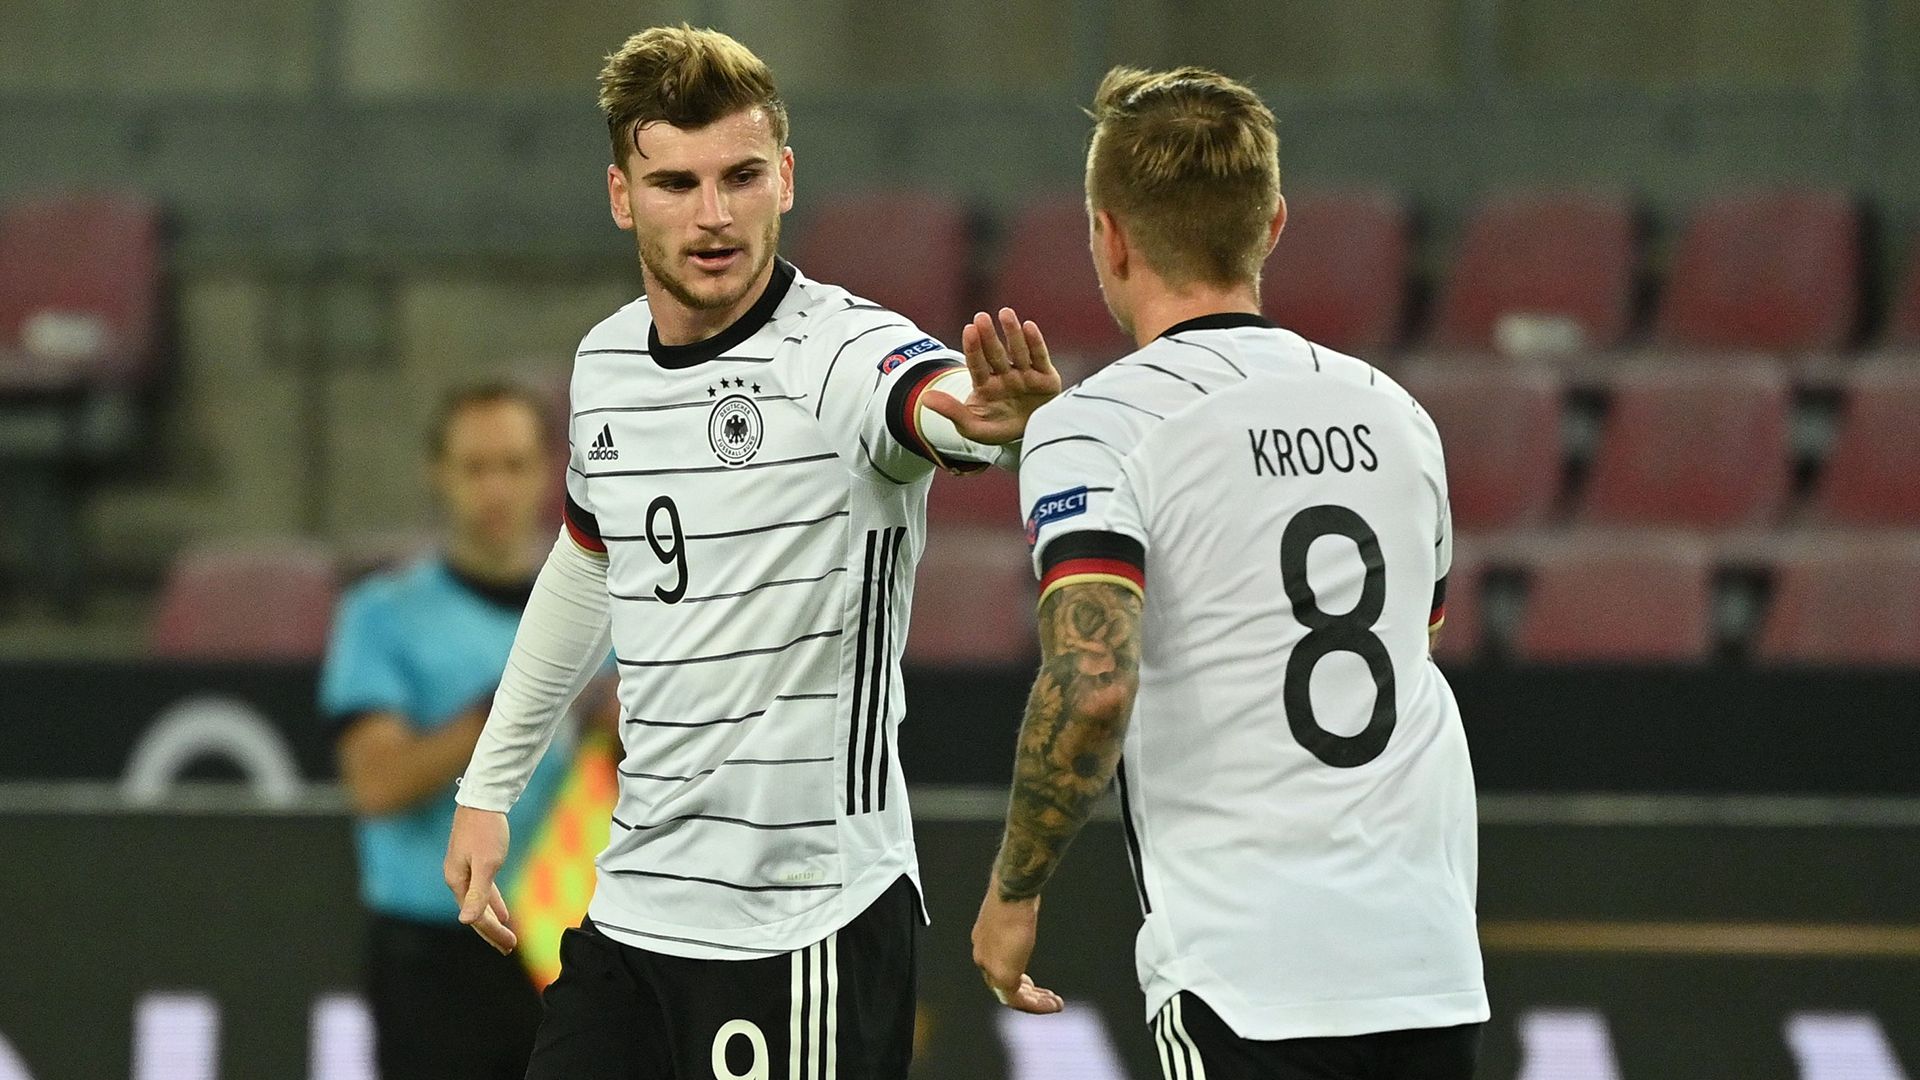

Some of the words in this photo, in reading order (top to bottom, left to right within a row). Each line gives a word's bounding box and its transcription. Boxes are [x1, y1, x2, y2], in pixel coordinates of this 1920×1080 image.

[588, 447, 619, 461] adidas
[1248, 424, 1378, 477] KROOS
[645, 495, 688, 604] 9
[1280, 504, 1397, 769] 8
[711, 1018, 769, 1080] 9
